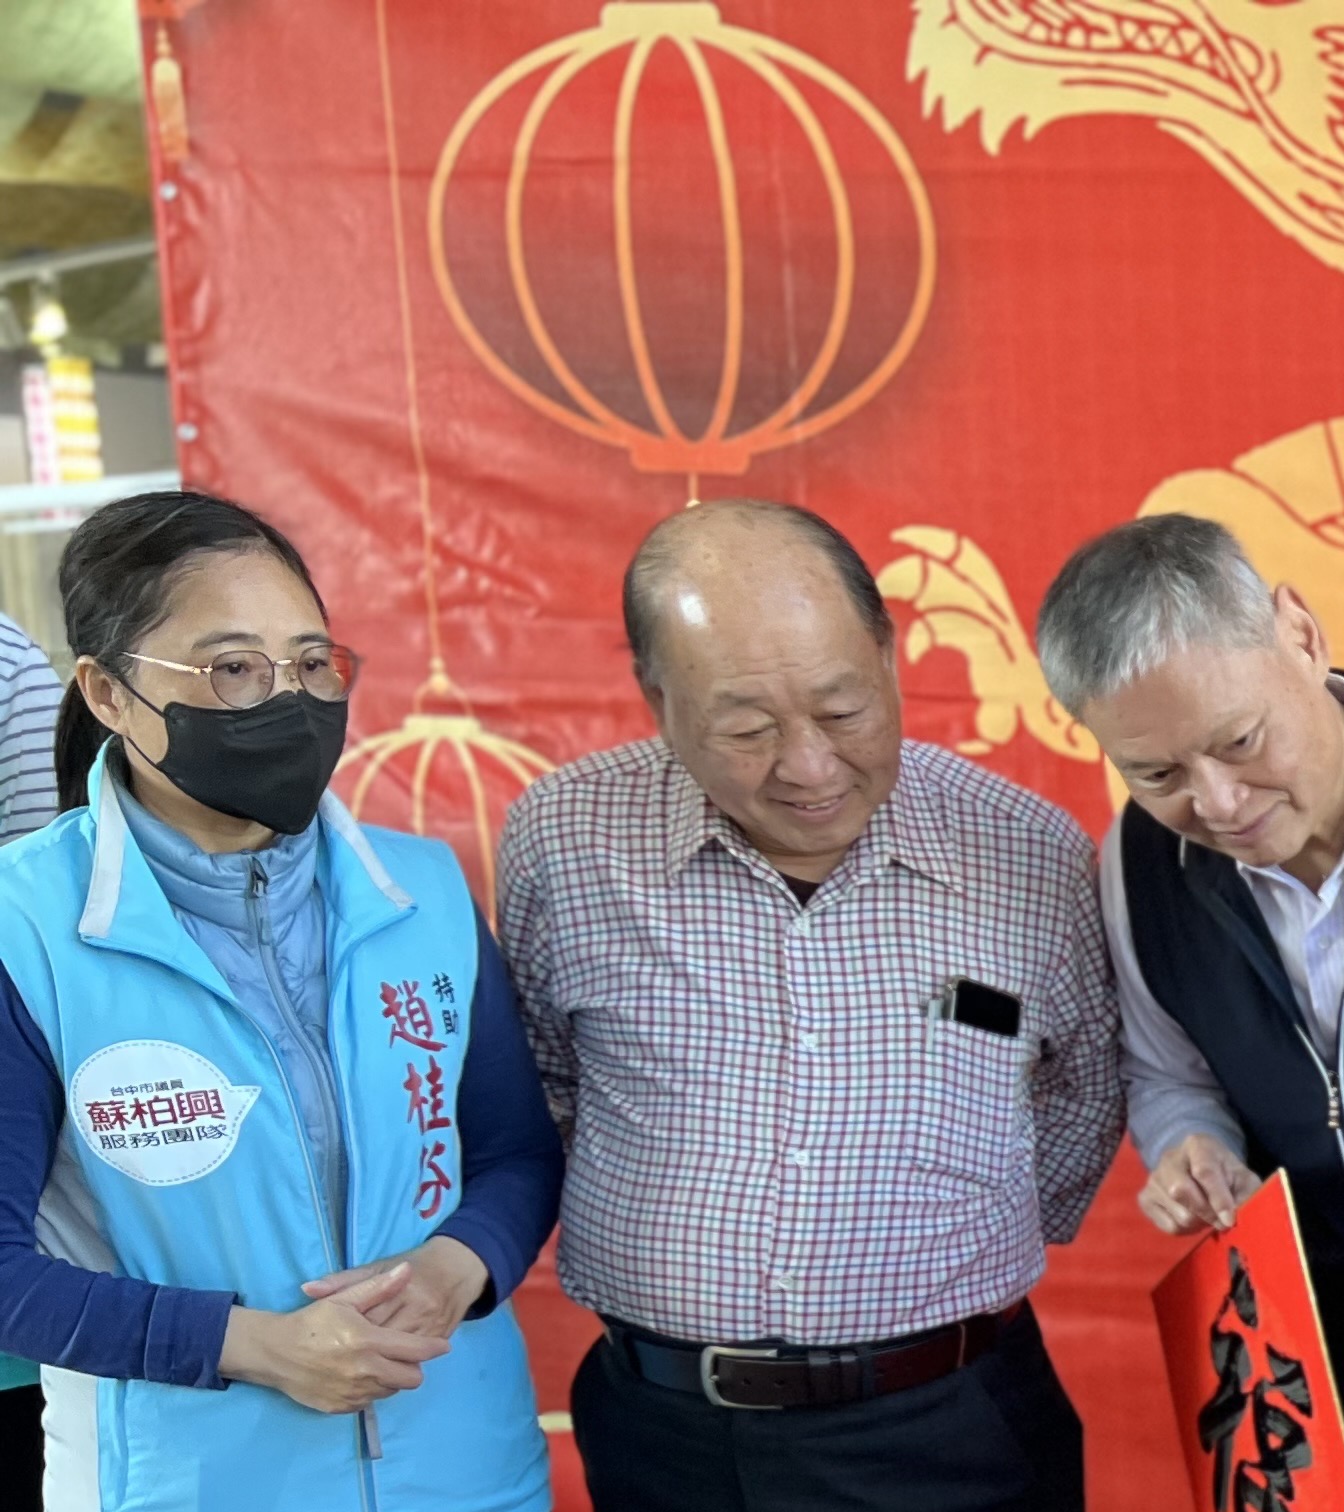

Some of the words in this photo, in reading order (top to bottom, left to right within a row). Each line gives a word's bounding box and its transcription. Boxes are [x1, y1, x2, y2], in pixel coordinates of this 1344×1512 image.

[110, 1078, 185, 1097] 台中市議員
[85, 1088, 226, 1133] 蘇柏興
[99, 1123, 230, 1150] 服務團隊
